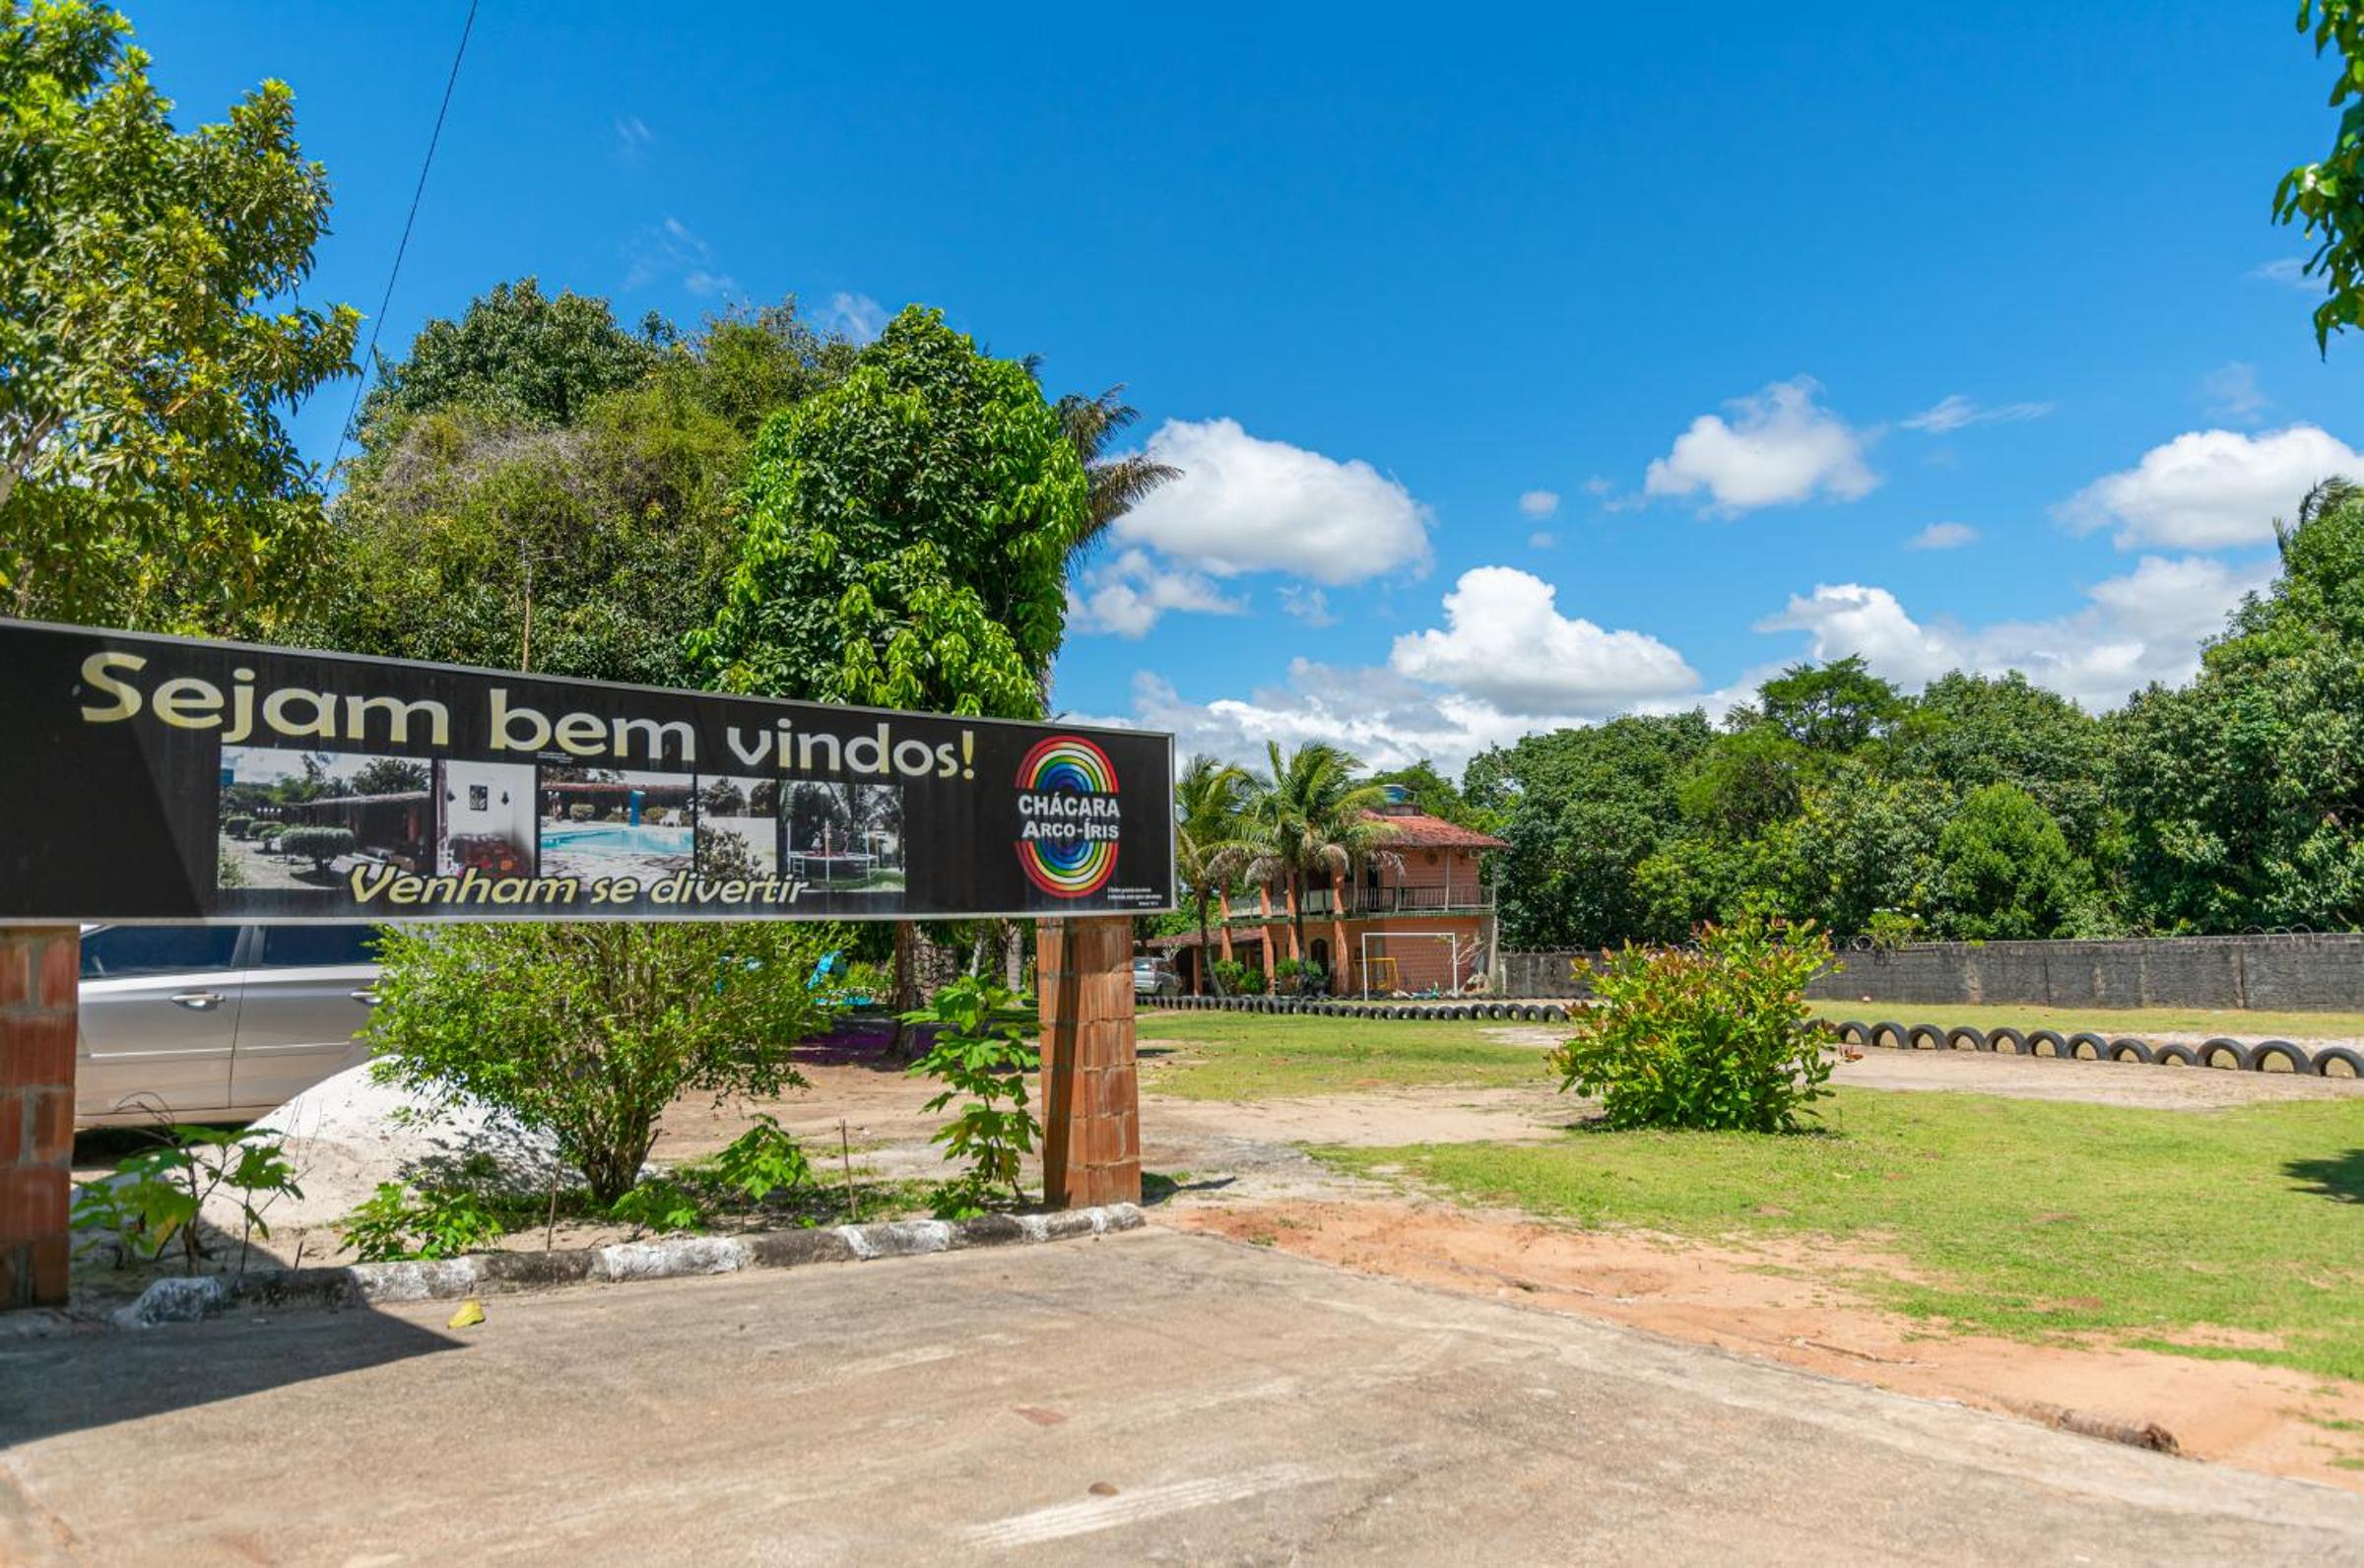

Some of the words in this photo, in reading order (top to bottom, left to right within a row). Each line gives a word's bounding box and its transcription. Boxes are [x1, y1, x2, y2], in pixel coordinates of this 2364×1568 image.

[81, 651, 450, 745] Sejam
[490, 688, 695, 762] bem
[727, 718, 976, 780] vindos!
[1018, 792, 1121, 817] CHÁCARA
[350, 864, 576, 905] Venham
[591, 872, 635, 904] se
[650, 868, 806, 904] divertir
